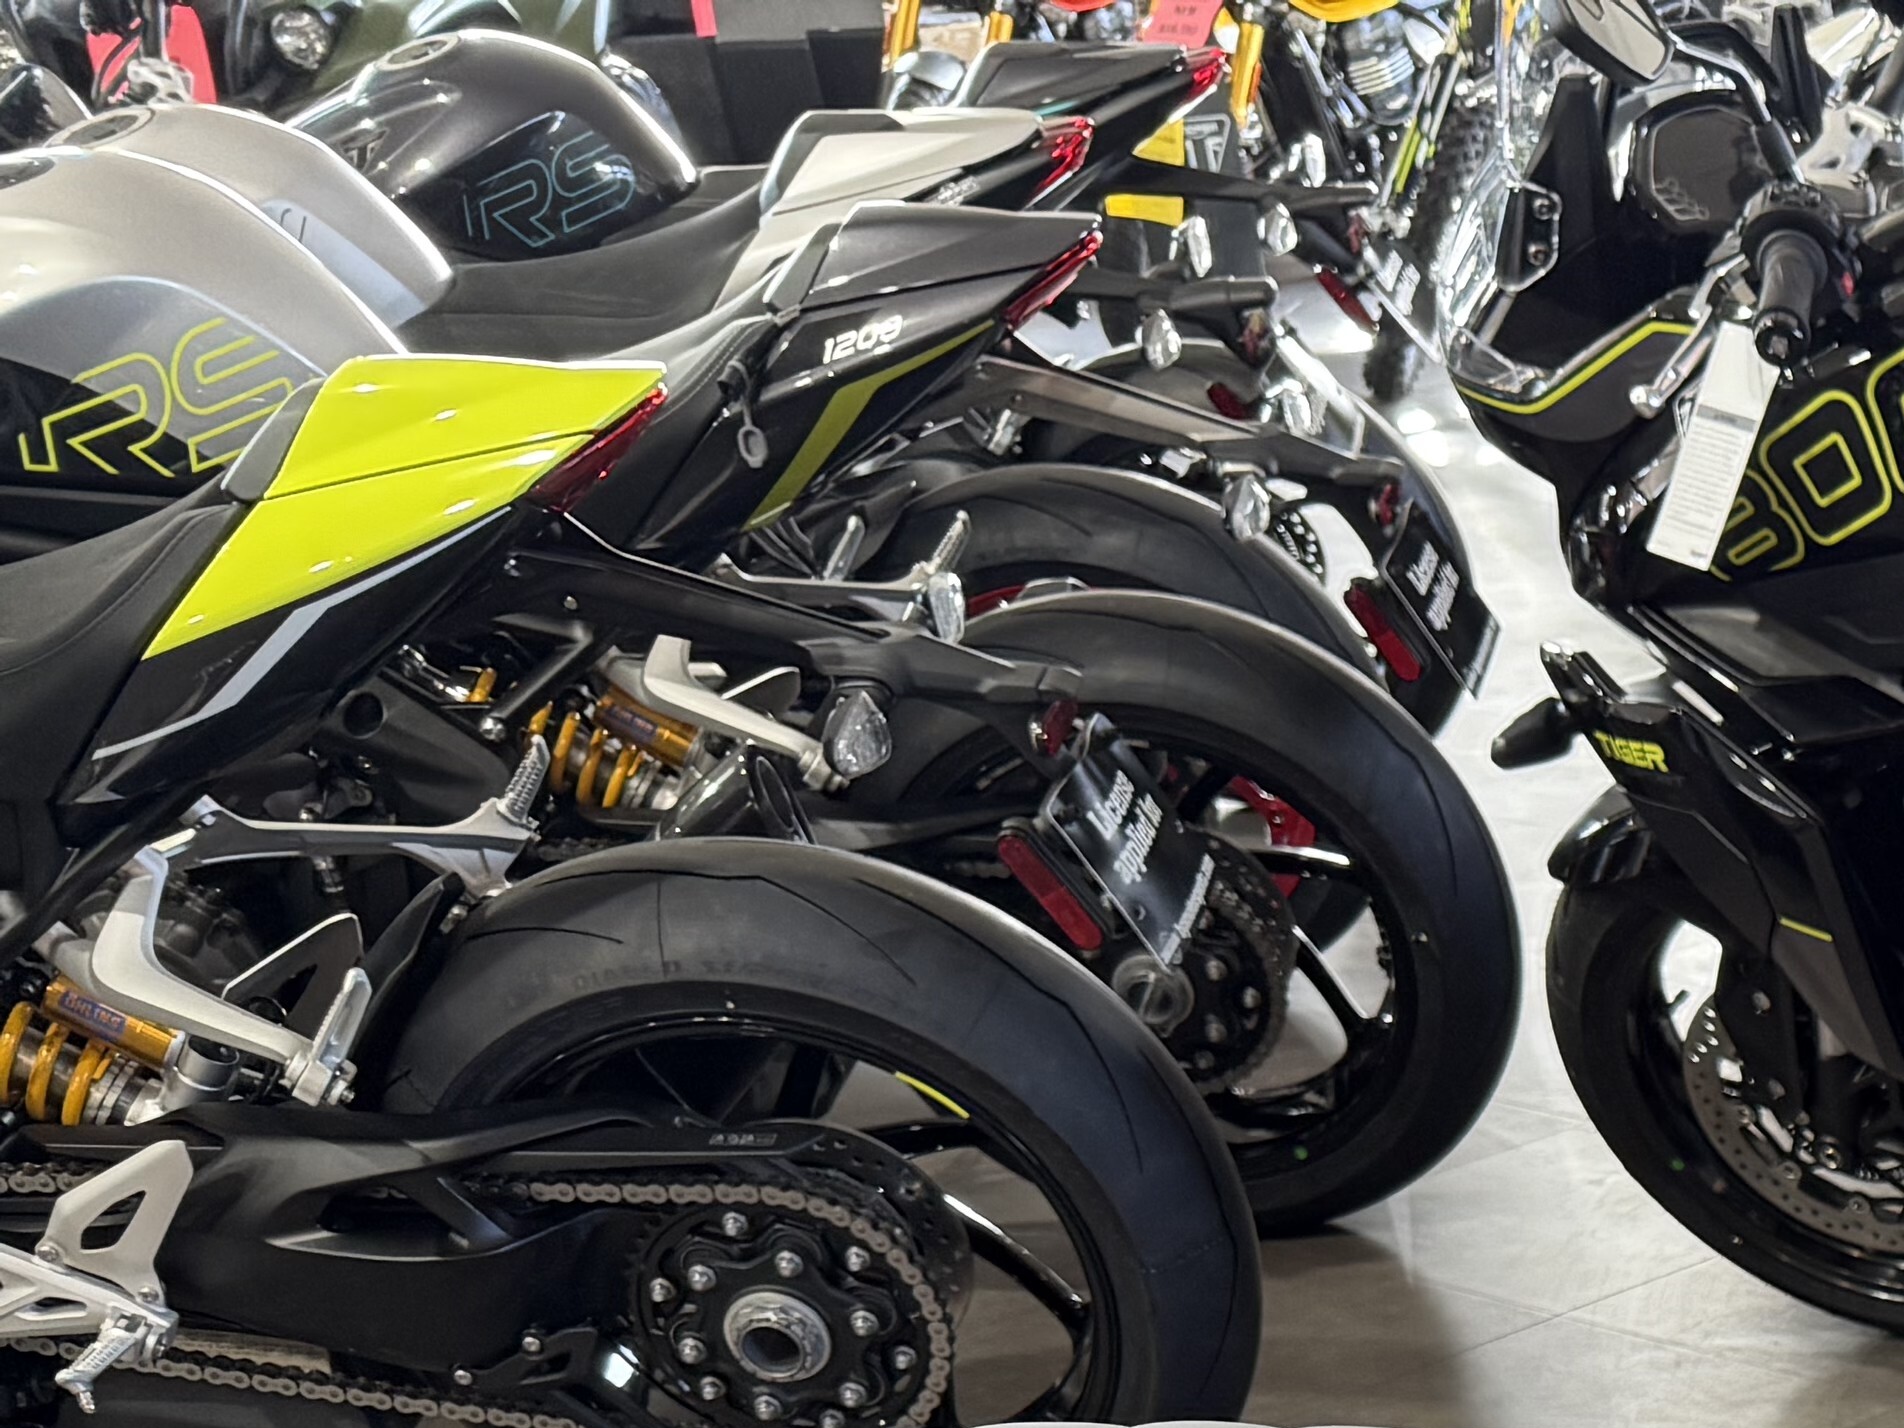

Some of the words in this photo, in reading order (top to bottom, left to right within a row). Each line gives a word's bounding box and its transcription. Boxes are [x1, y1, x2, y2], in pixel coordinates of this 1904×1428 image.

[464, 126, 636, 248] RS
[18, 317, 295, 478] RS
[1592, 729, 1669, 773] TIGER
[1086, 769, 1135, 841] License
[1113, 806, 1158, 885] applied
